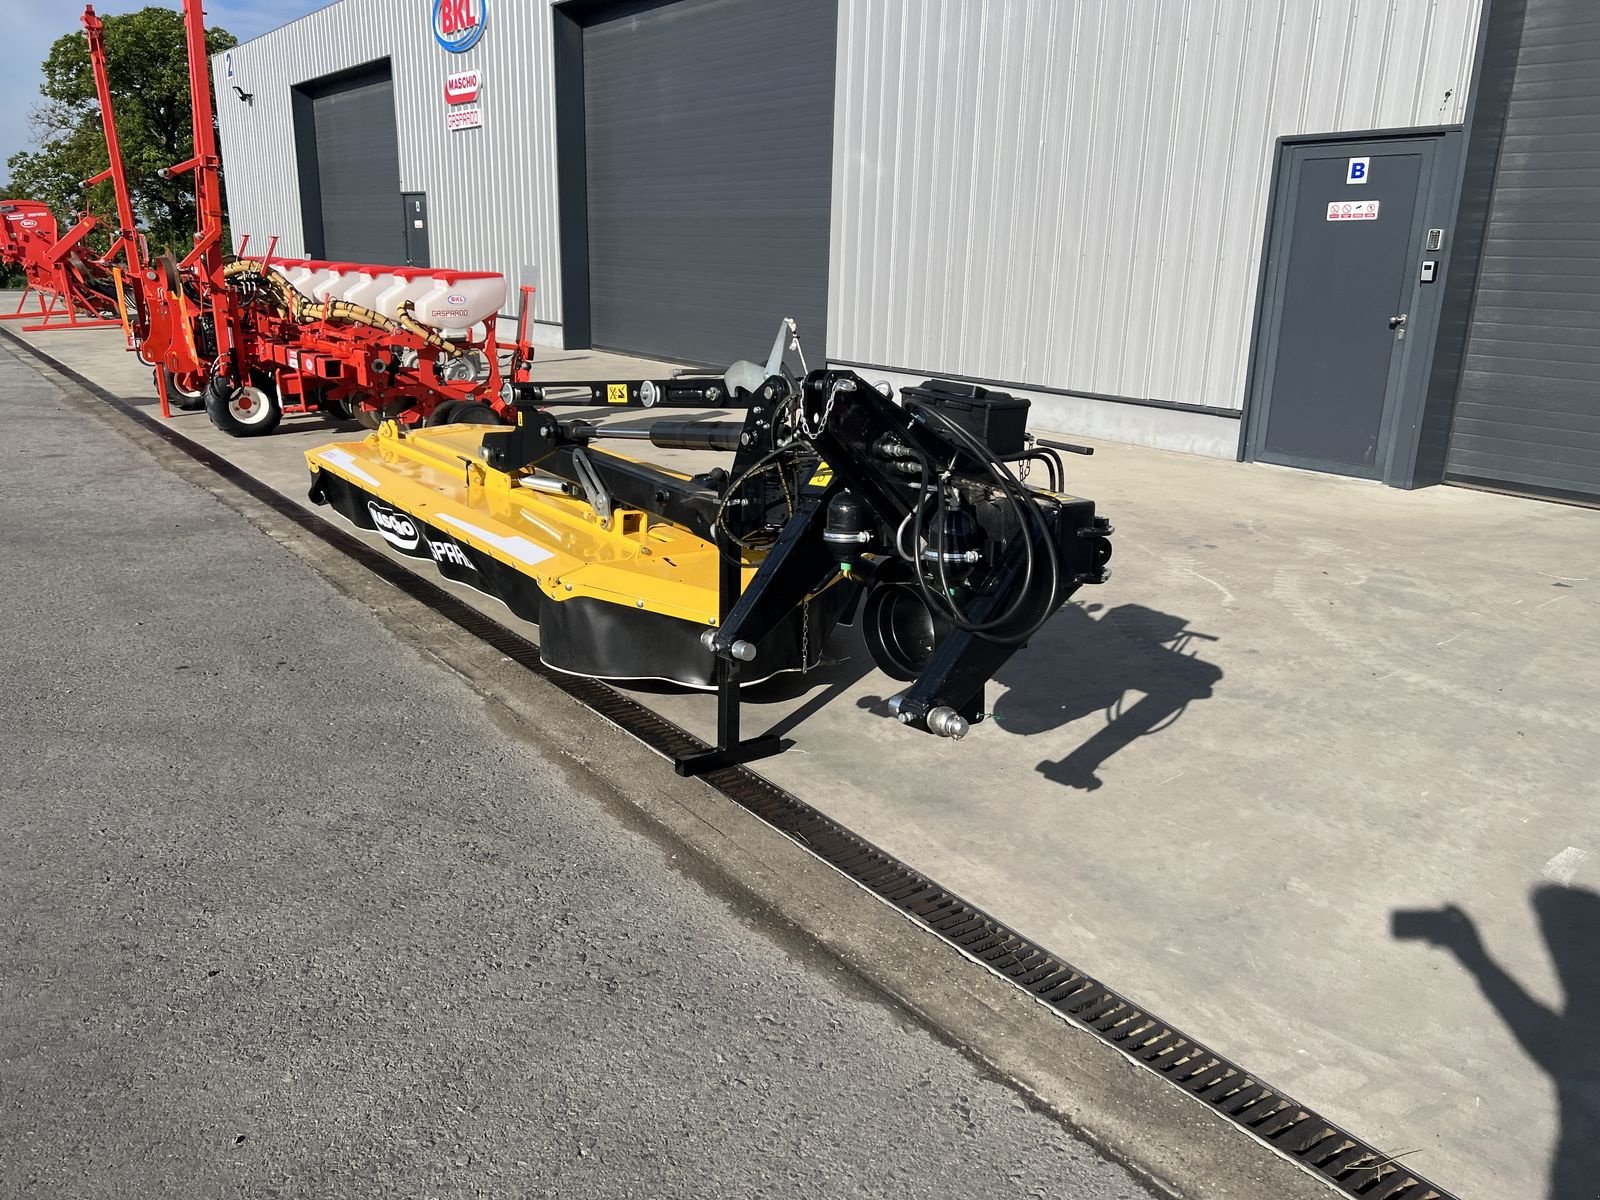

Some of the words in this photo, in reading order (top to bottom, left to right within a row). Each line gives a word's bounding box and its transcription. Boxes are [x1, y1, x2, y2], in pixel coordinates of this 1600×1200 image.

[226, 53, 232, 77] 2
[449, 75, 477, 90] MASCHIO
[448, 111, 478, 127] GASPARDO
[1350, 163, 1365, 179] B
